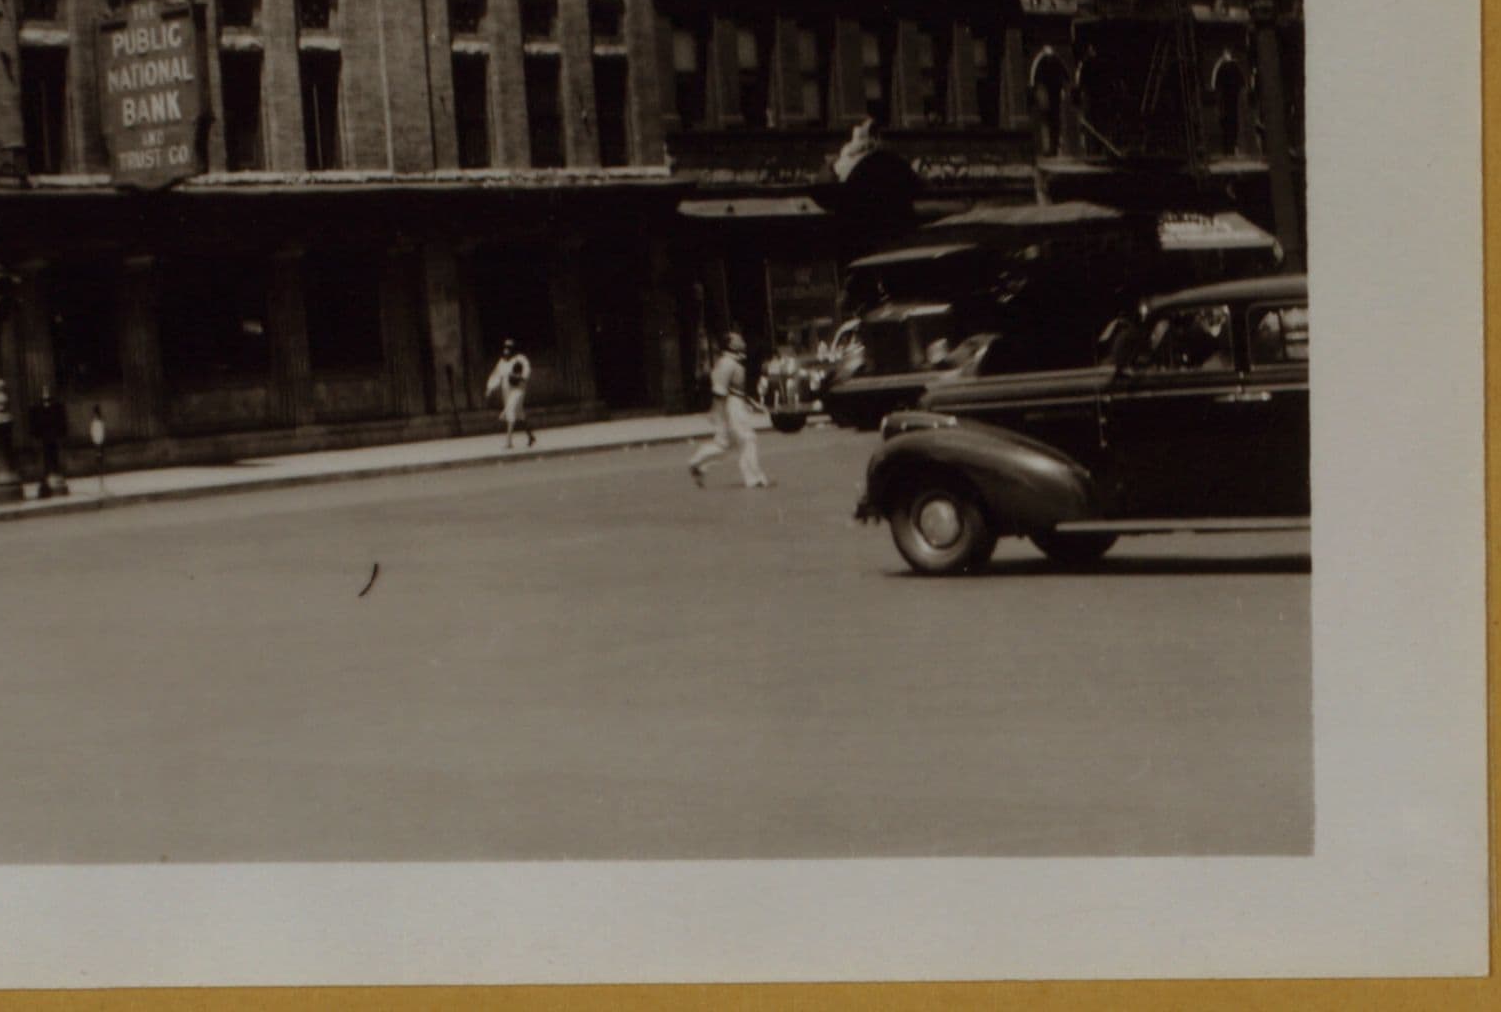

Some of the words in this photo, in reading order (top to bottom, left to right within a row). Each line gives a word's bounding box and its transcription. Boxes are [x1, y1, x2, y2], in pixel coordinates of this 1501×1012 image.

[132, 4, 156, 20] THE
[113, 22, 182, 56] PUBLIC
[107, 58, 194, 92] NATIONAL
[122, 92, 182, 126] BANK
[118, 147, 163, 171] TRUST
